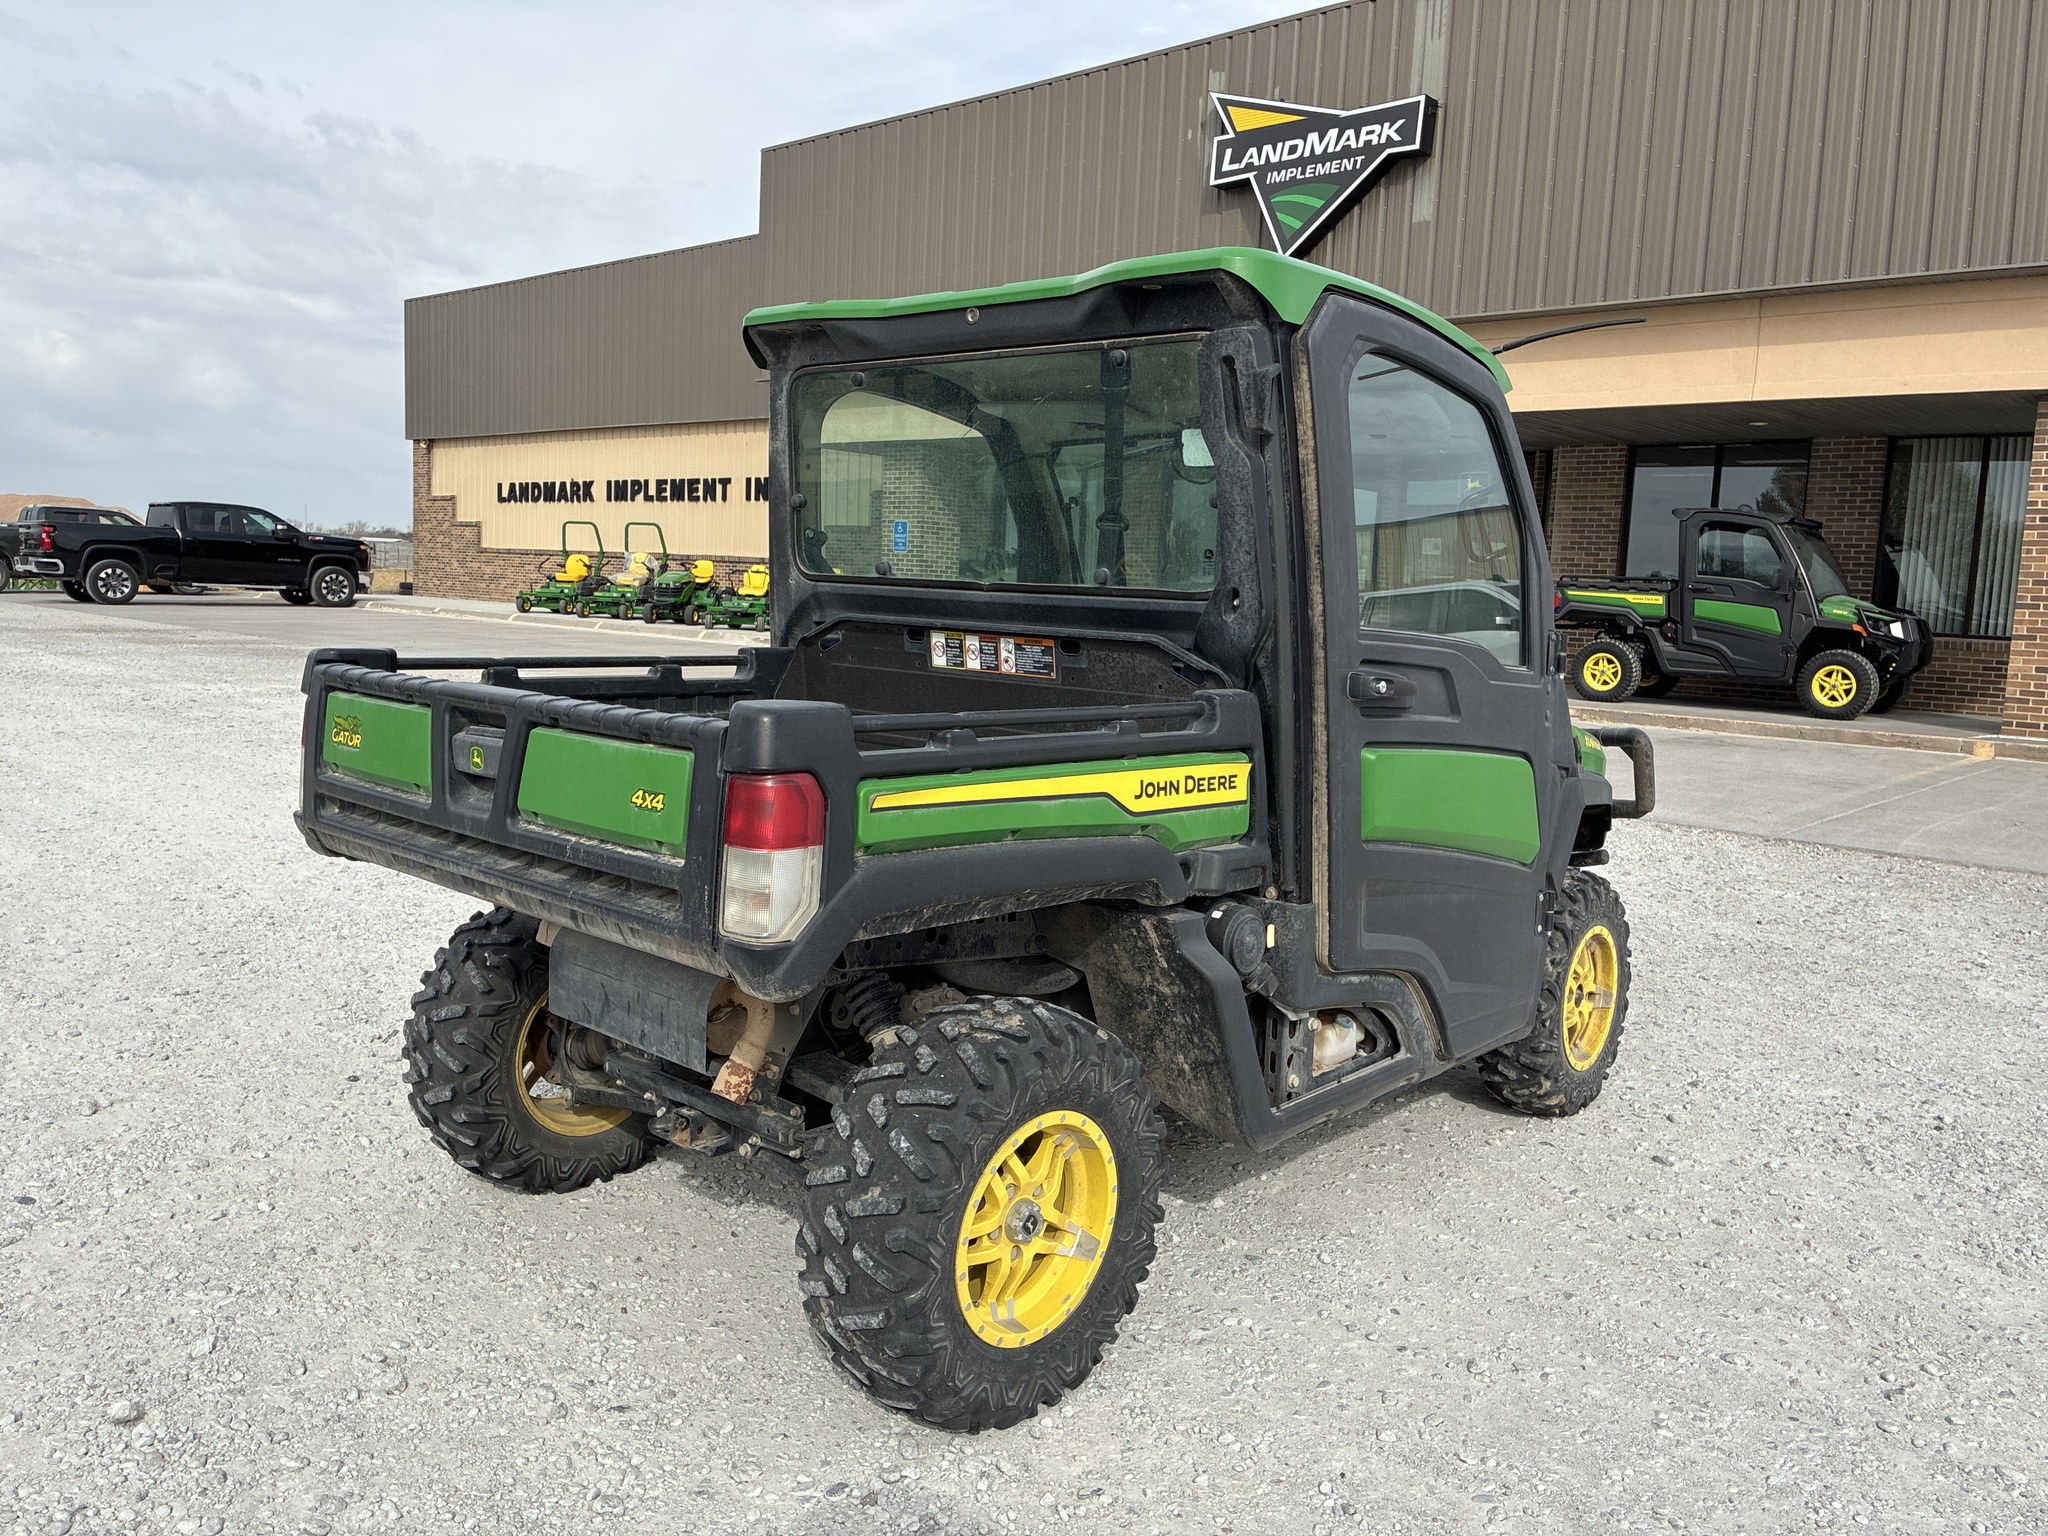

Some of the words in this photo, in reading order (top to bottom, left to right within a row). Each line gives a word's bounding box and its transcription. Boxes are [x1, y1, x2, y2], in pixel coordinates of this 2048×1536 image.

[1221, 119, 1406, 172] LANDMARK
[1266, 155, 1366, 185] IMPLEMENT
[497, 480, 595, 503] LANDMARK
[606, 477, 732, 503] IMPLEMENT
[332, 727, 362, 748] GATOR
[1134, 779, 1180, 800] JOHN
[1184, 774, 1238, 795] DEERE
